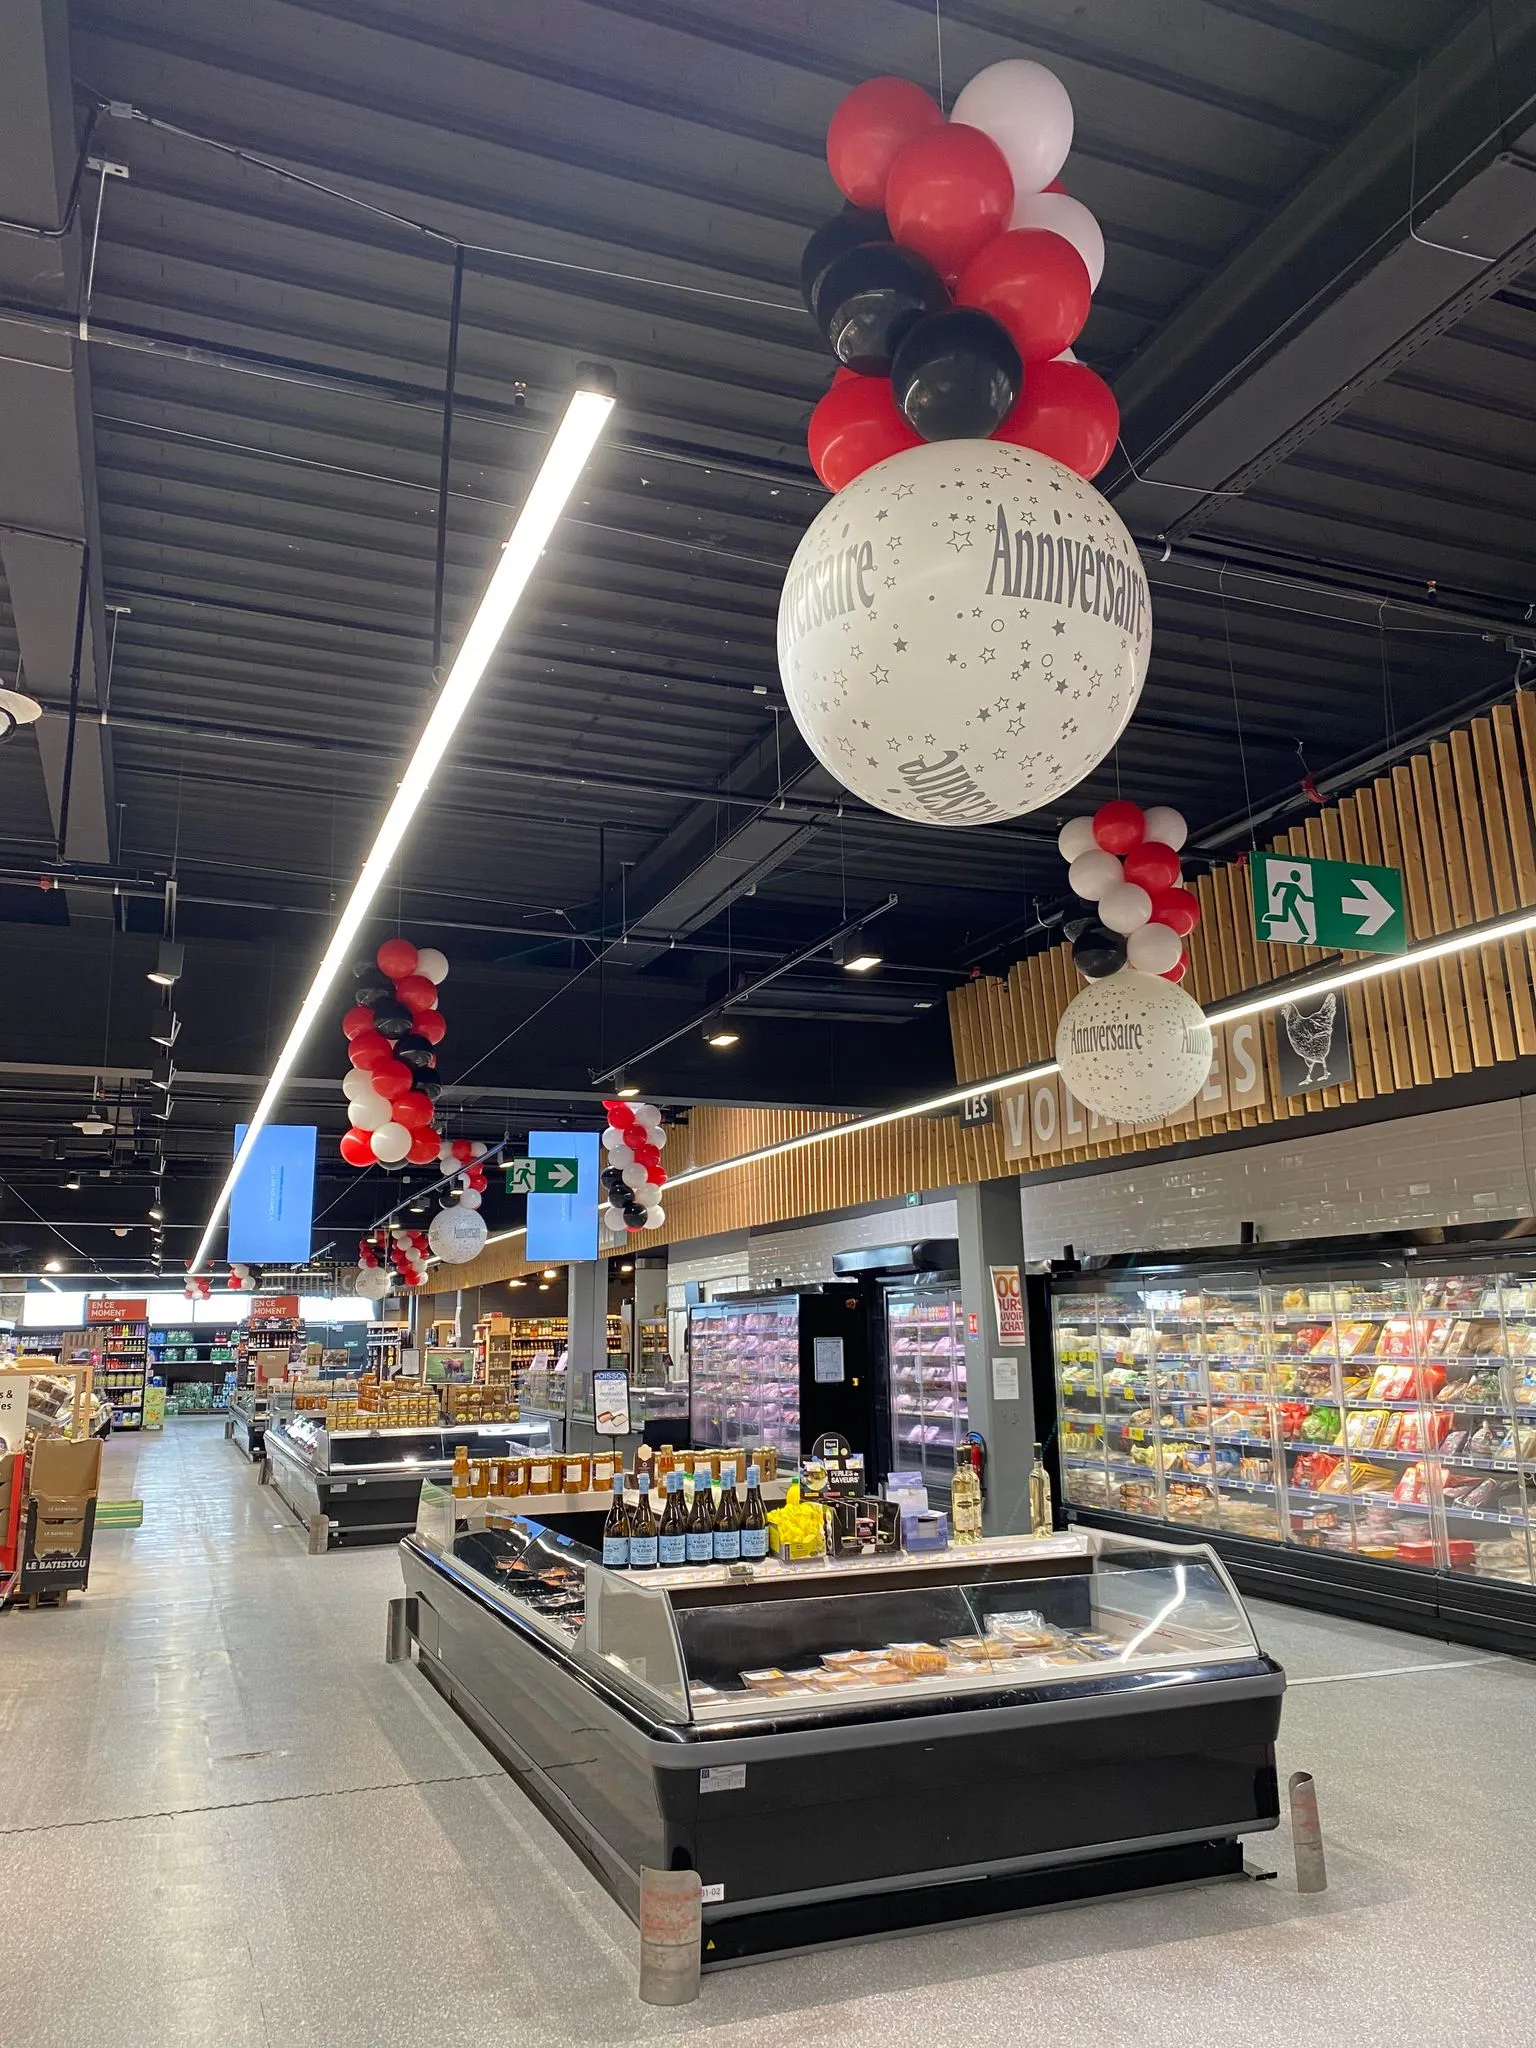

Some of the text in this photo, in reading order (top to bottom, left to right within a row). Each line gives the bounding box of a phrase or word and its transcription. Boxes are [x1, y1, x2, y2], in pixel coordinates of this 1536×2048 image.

[985, 503, 1147, 643] Anniversaire
[1071, 1019, 1144, 1055] Anniversaire
[965, 1093, 988, 1121] LES
[91, 1309, 126, 1317] MOMENT
[254, 1307, 287, 1315] MOMENT
[25, 1559, 86, 1571] LE BATISTOU
